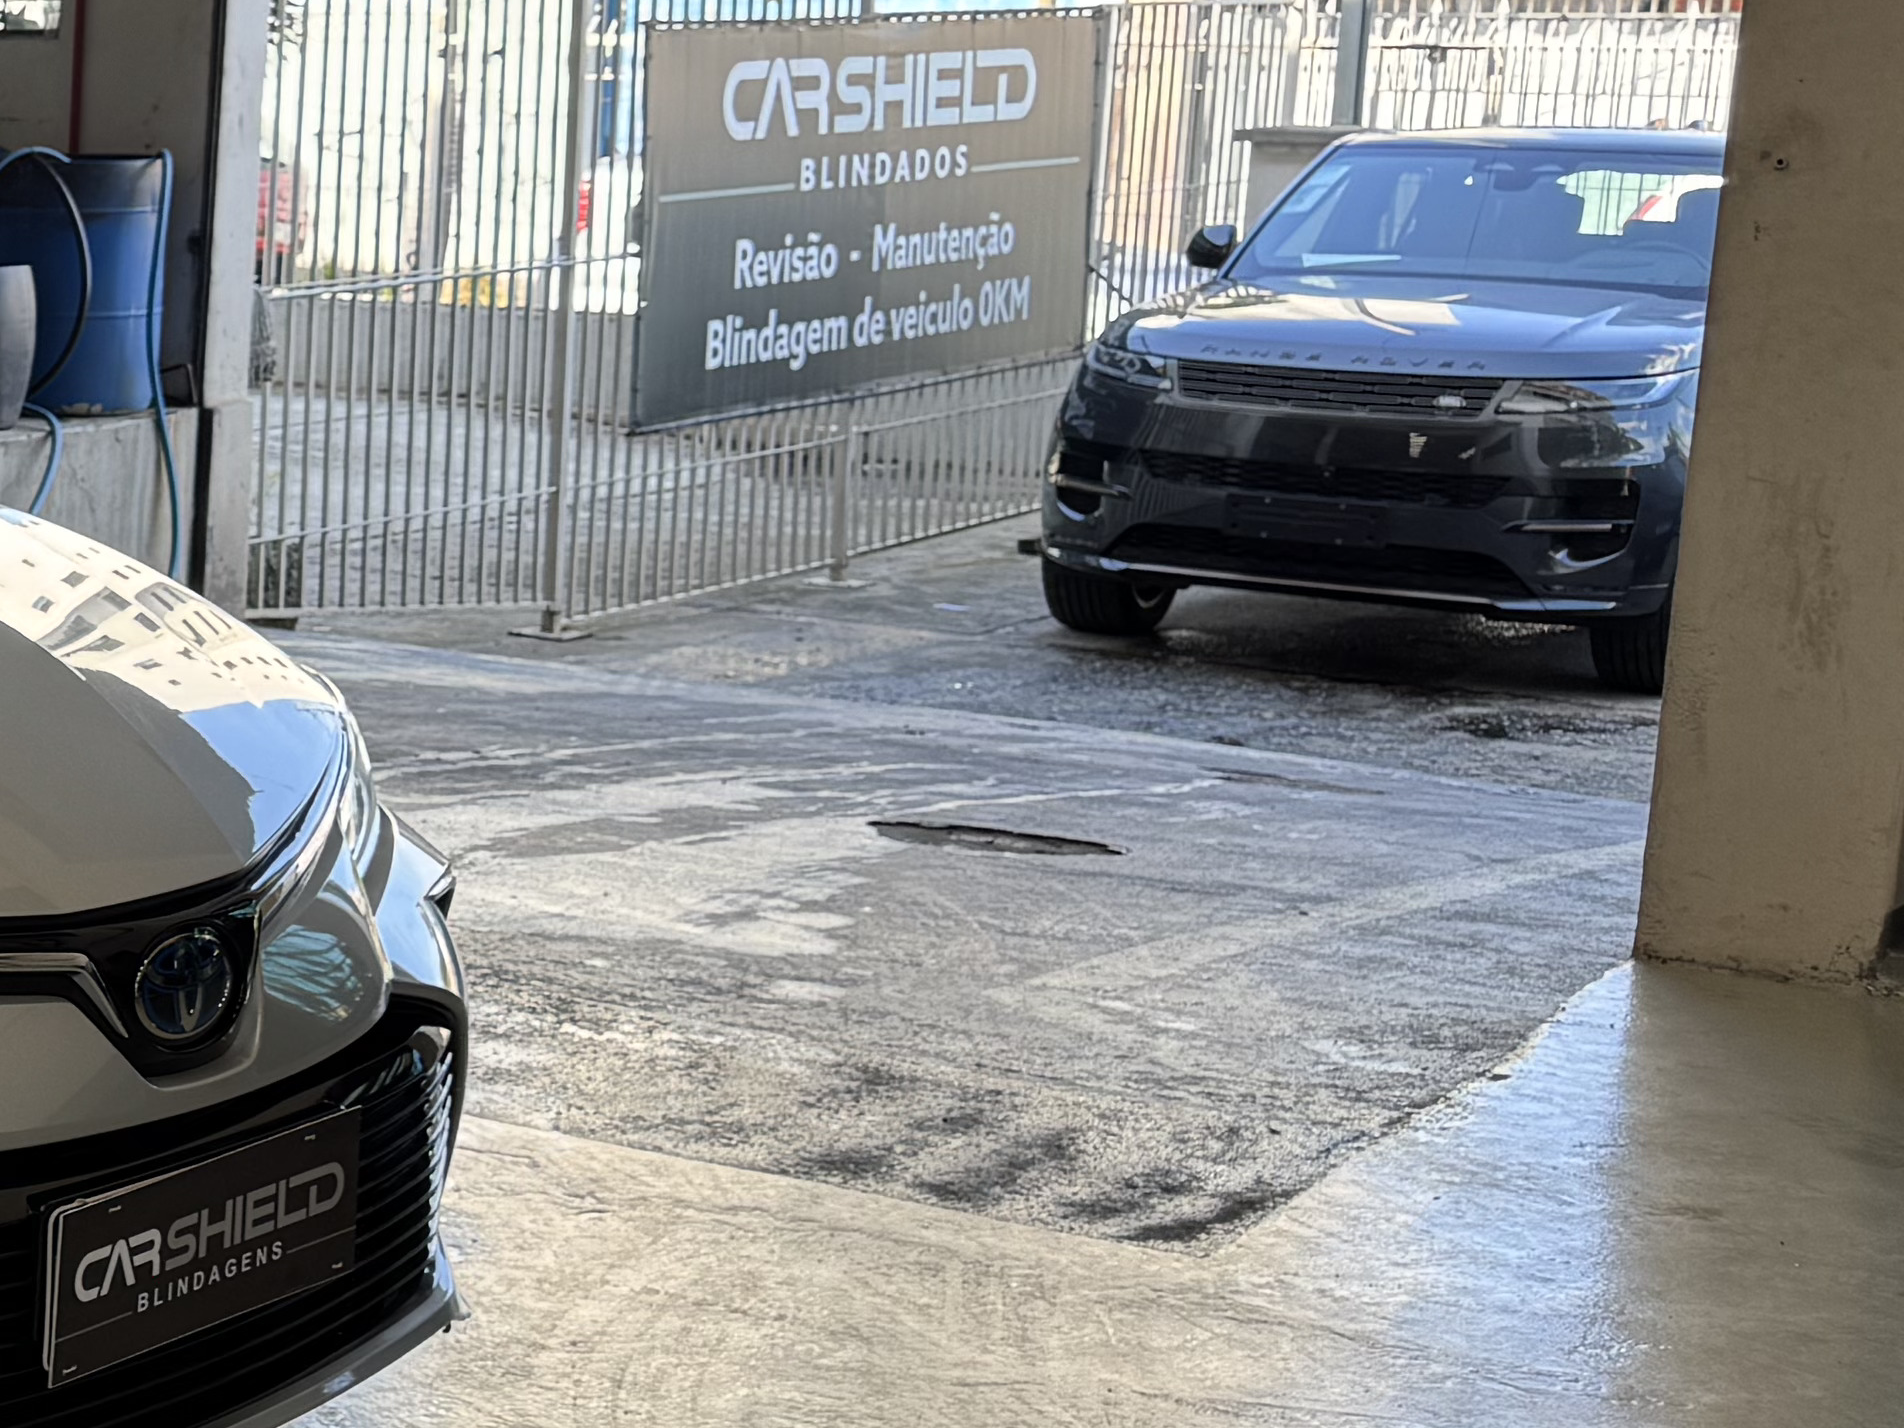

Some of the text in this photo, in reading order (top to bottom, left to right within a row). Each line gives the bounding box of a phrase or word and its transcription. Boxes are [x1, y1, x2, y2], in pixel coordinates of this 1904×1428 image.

[722, 47, 1037, 141] CARSHIELD
[799, 144, 969, 192] BLINDADOS
[734, 232, 839, 289] Revisão
[871, 212, 1015, 271] Manutenção
[704, 308, 848, 371] Blindagem
[853, 295, 885, 348] de
[74, 1162, 346, 1302] CARSHIELD
[137, 1240, 284, 1314] BLINDAGENS
